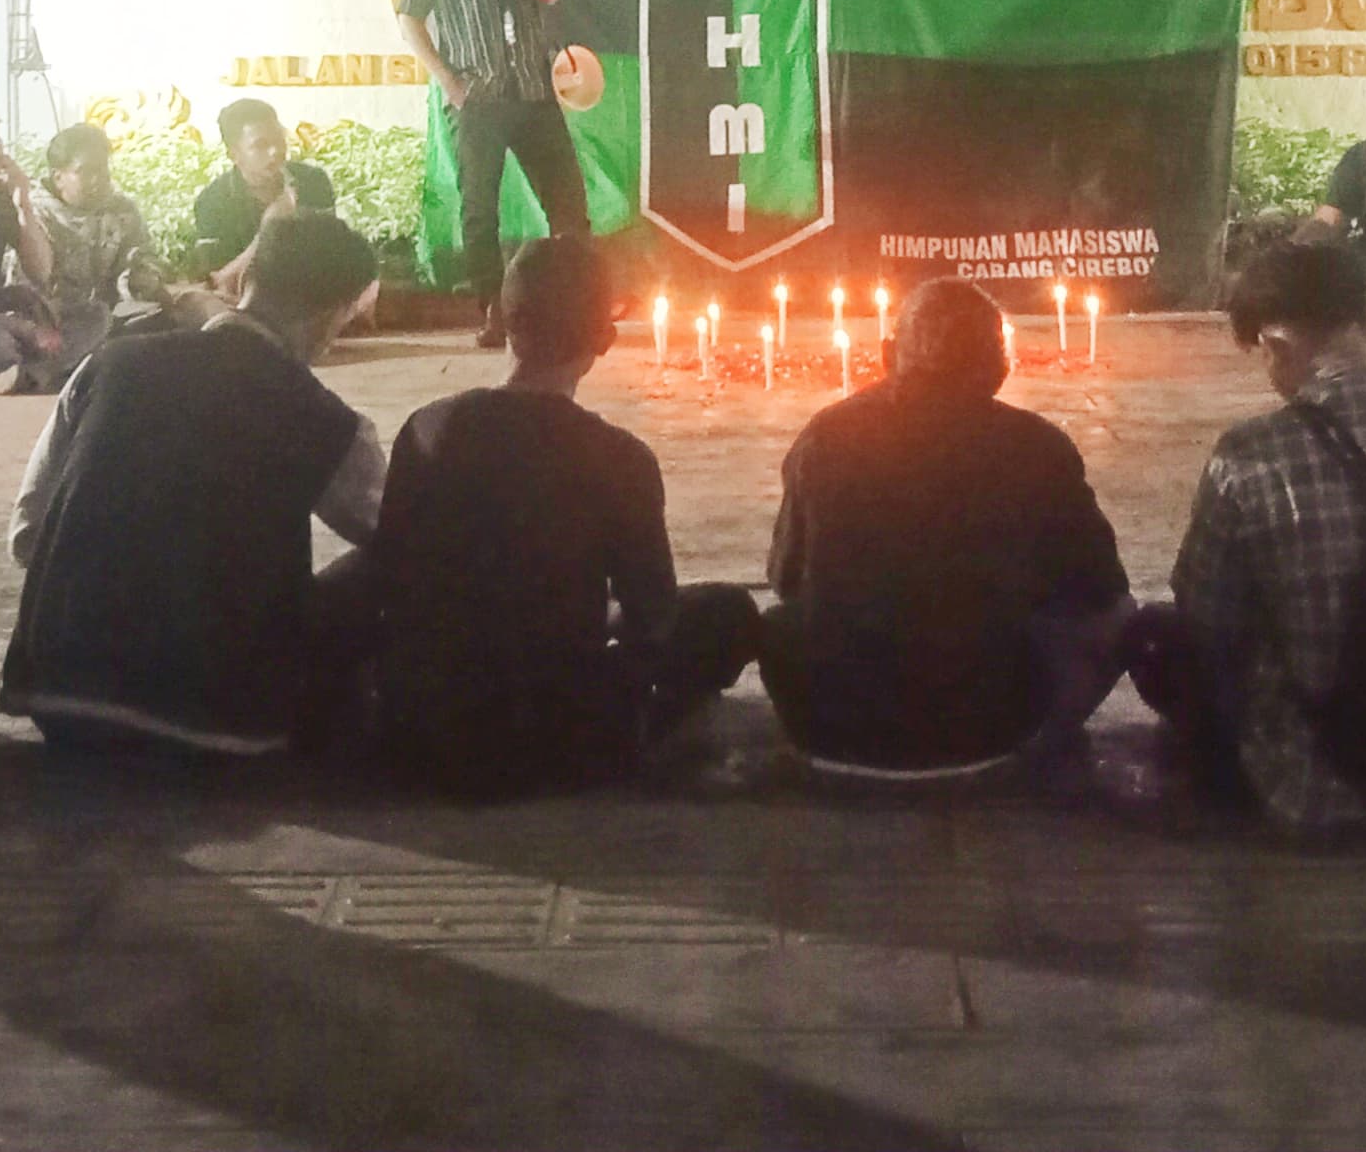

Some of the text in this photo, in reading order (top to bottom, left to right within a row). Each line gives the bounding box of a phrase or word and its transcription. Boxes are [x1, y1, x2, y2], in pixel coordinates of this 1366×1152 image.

[219, 54, 381, 86] JALAN
[879, 228, 1161, 260] HIMPUNAN MAHASISWA
[957, 256, 1156, 279] CABANG CIREBO
